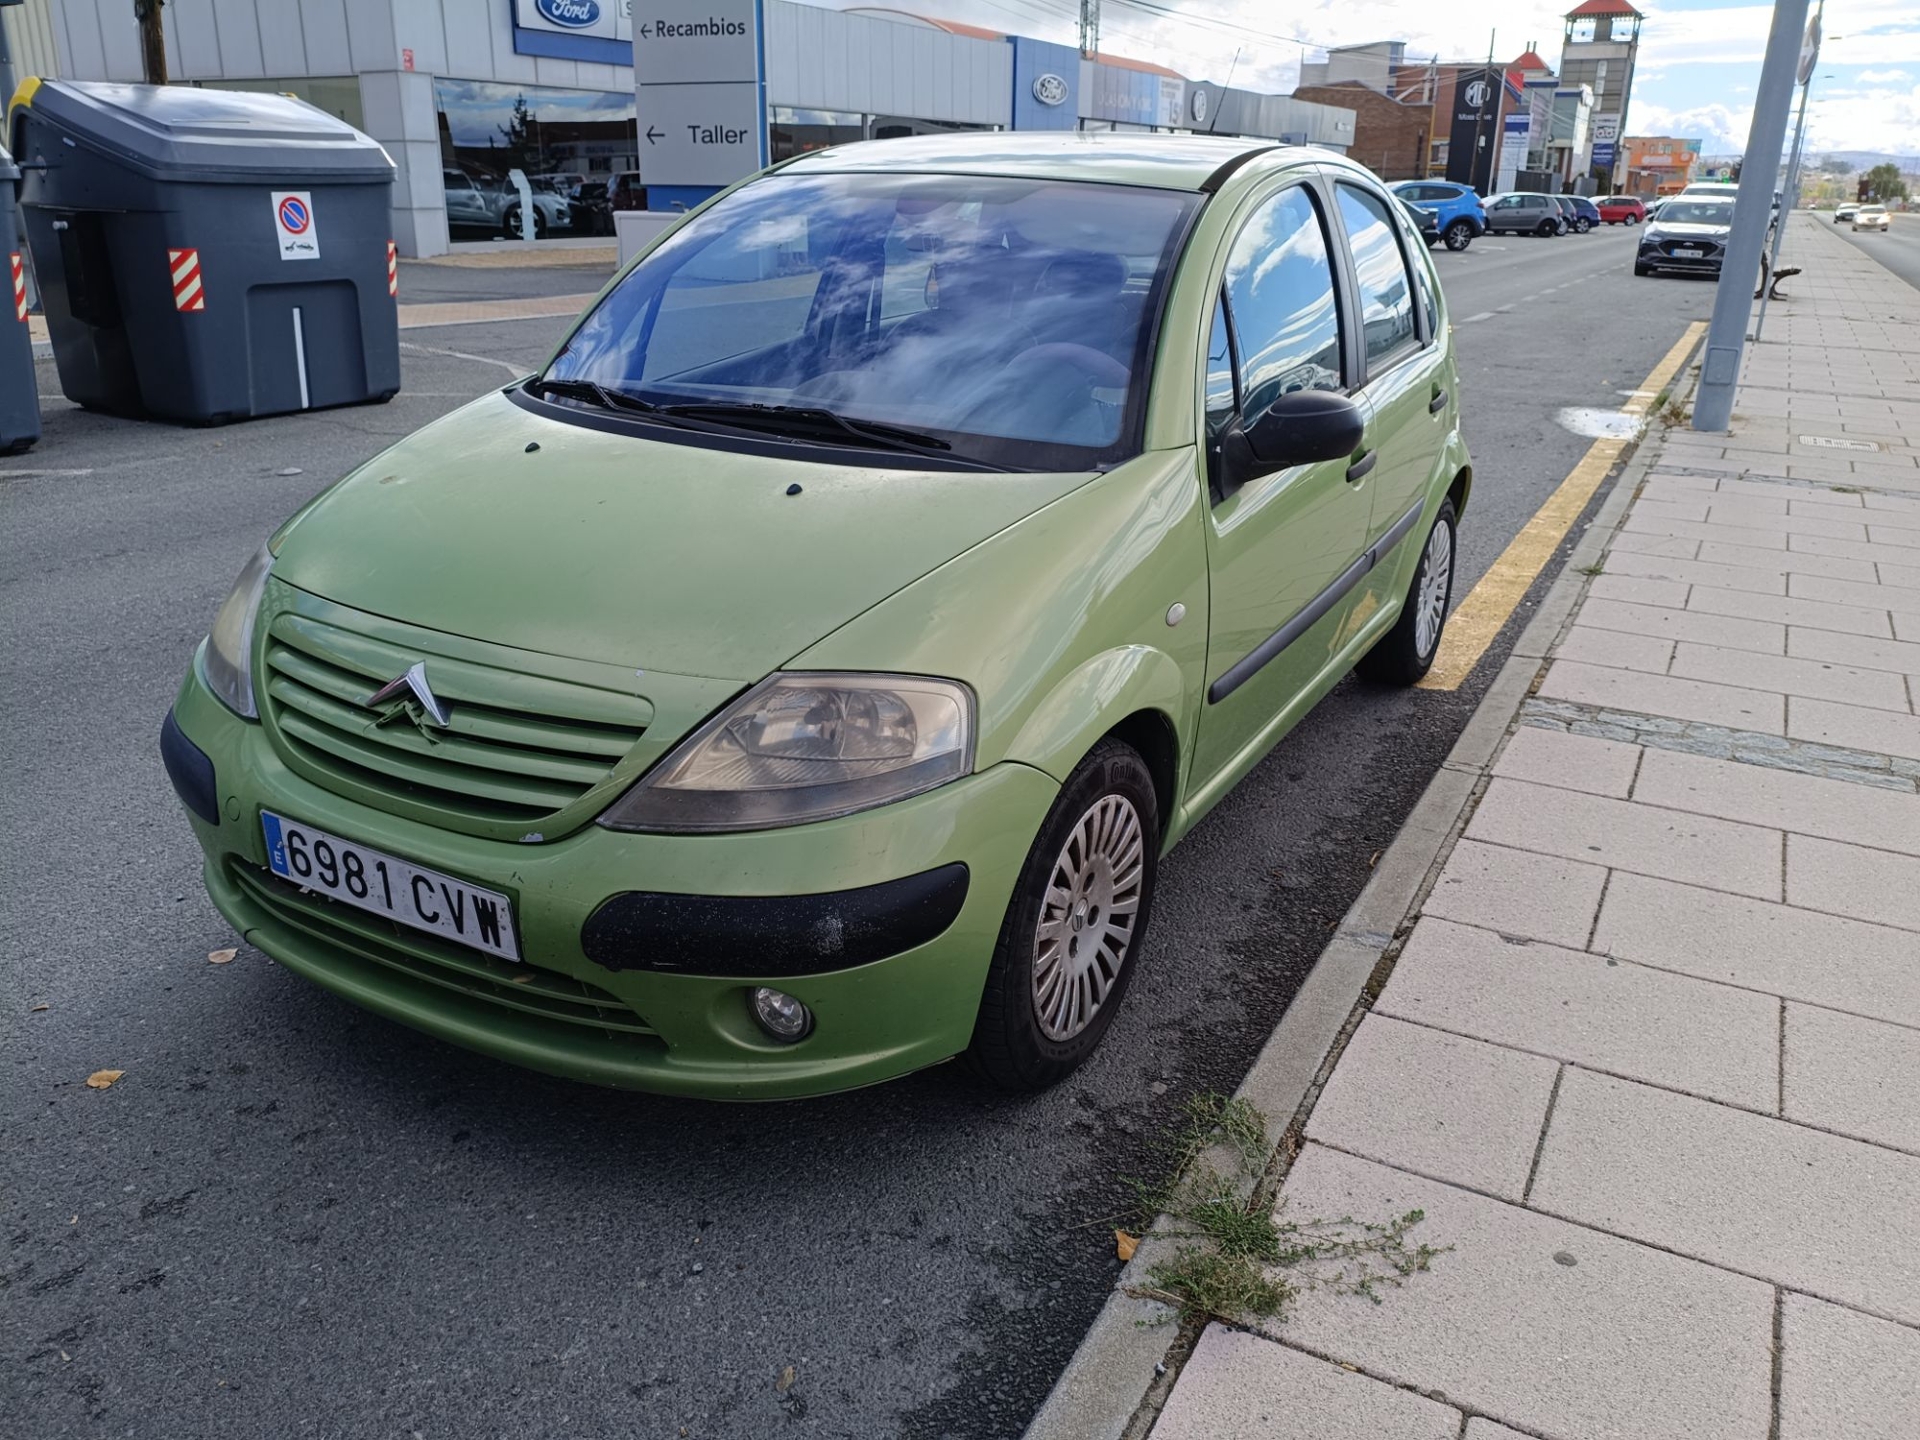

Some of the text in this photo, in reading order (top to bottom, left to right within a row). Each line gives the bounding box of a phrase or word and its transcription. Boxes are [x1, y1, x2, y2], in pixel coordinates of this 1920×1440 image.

[552, 0, 590, 20] Ford
[655, 16, 746, 38] Recambios
[687, 125, 748, 145] Taller
[273, 850, 283, 865] E
[286, 829, 501, 949] 6981 CVW
